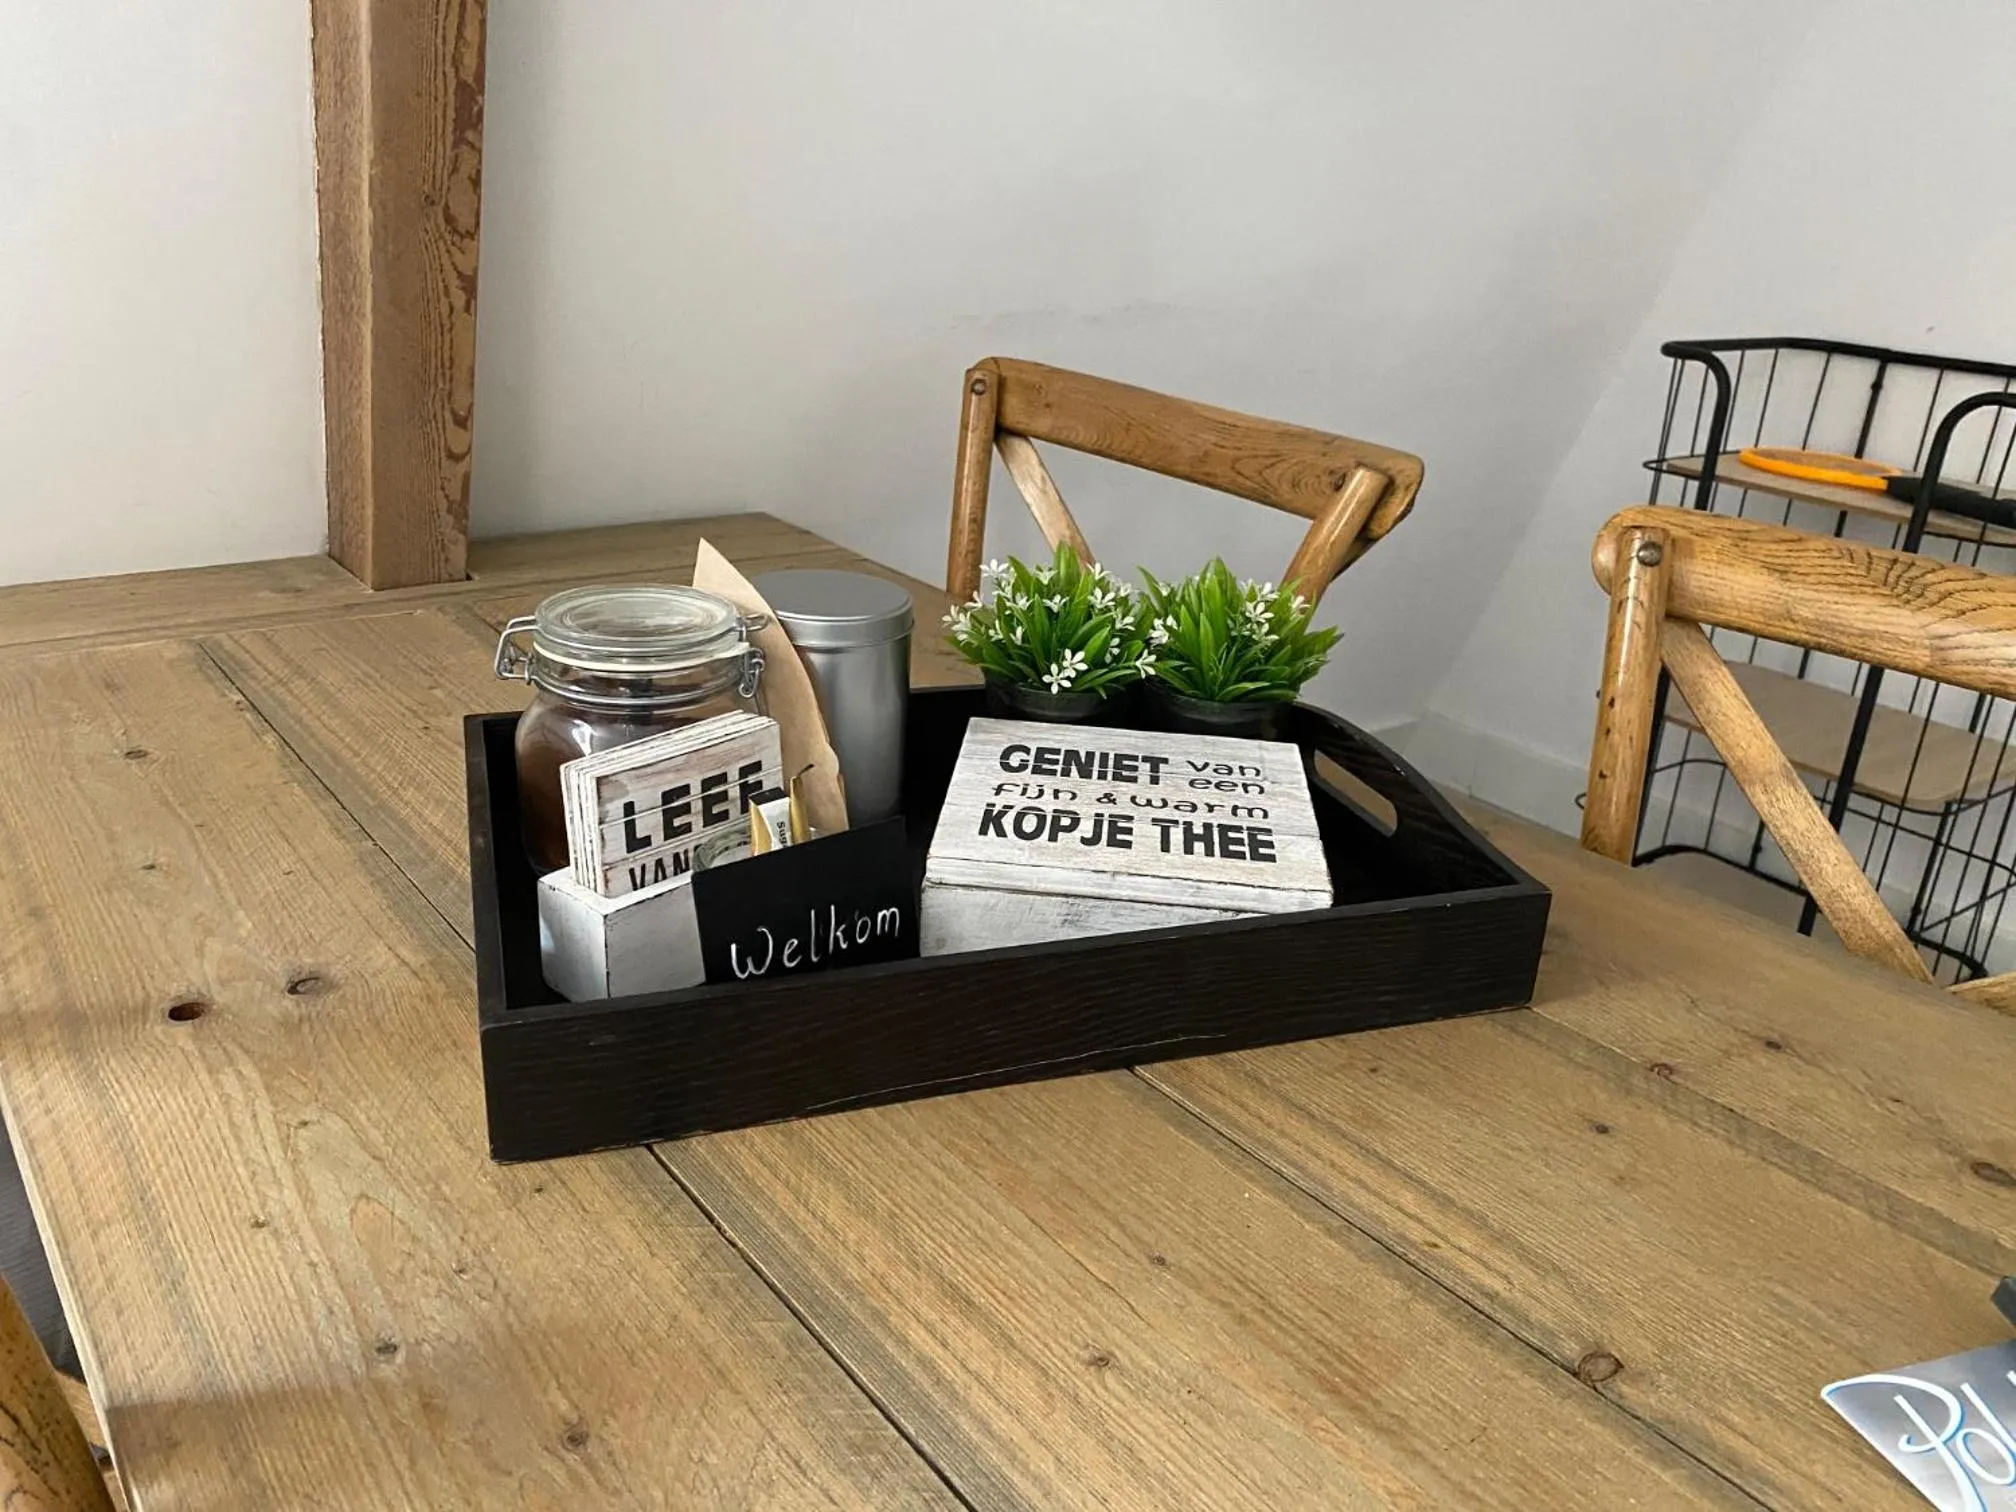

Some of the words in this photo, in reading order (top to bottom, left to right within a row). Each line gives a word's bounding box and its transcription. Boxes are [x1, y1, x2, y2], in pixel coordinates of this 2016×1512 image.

[999, 744, 1169, 786] GENIET
[1186, 760, 1262, 778] van
[1188, 777, 1266, 796] een
[623, 760, 763, 854] LEEF
[992, 782, 1078, 803] fijn
[1096, 791, 1119, 806] &
[1131, 794, 1270, 820] warm
[776, 821, 788, 848] Sug
[978, 802, 1135, 850] KOPJE
[1151, 816, 1278, 864] THEE
[730, 904, 901, 981] Welkom
[1820, 1370, 2016, 1512] Pol
